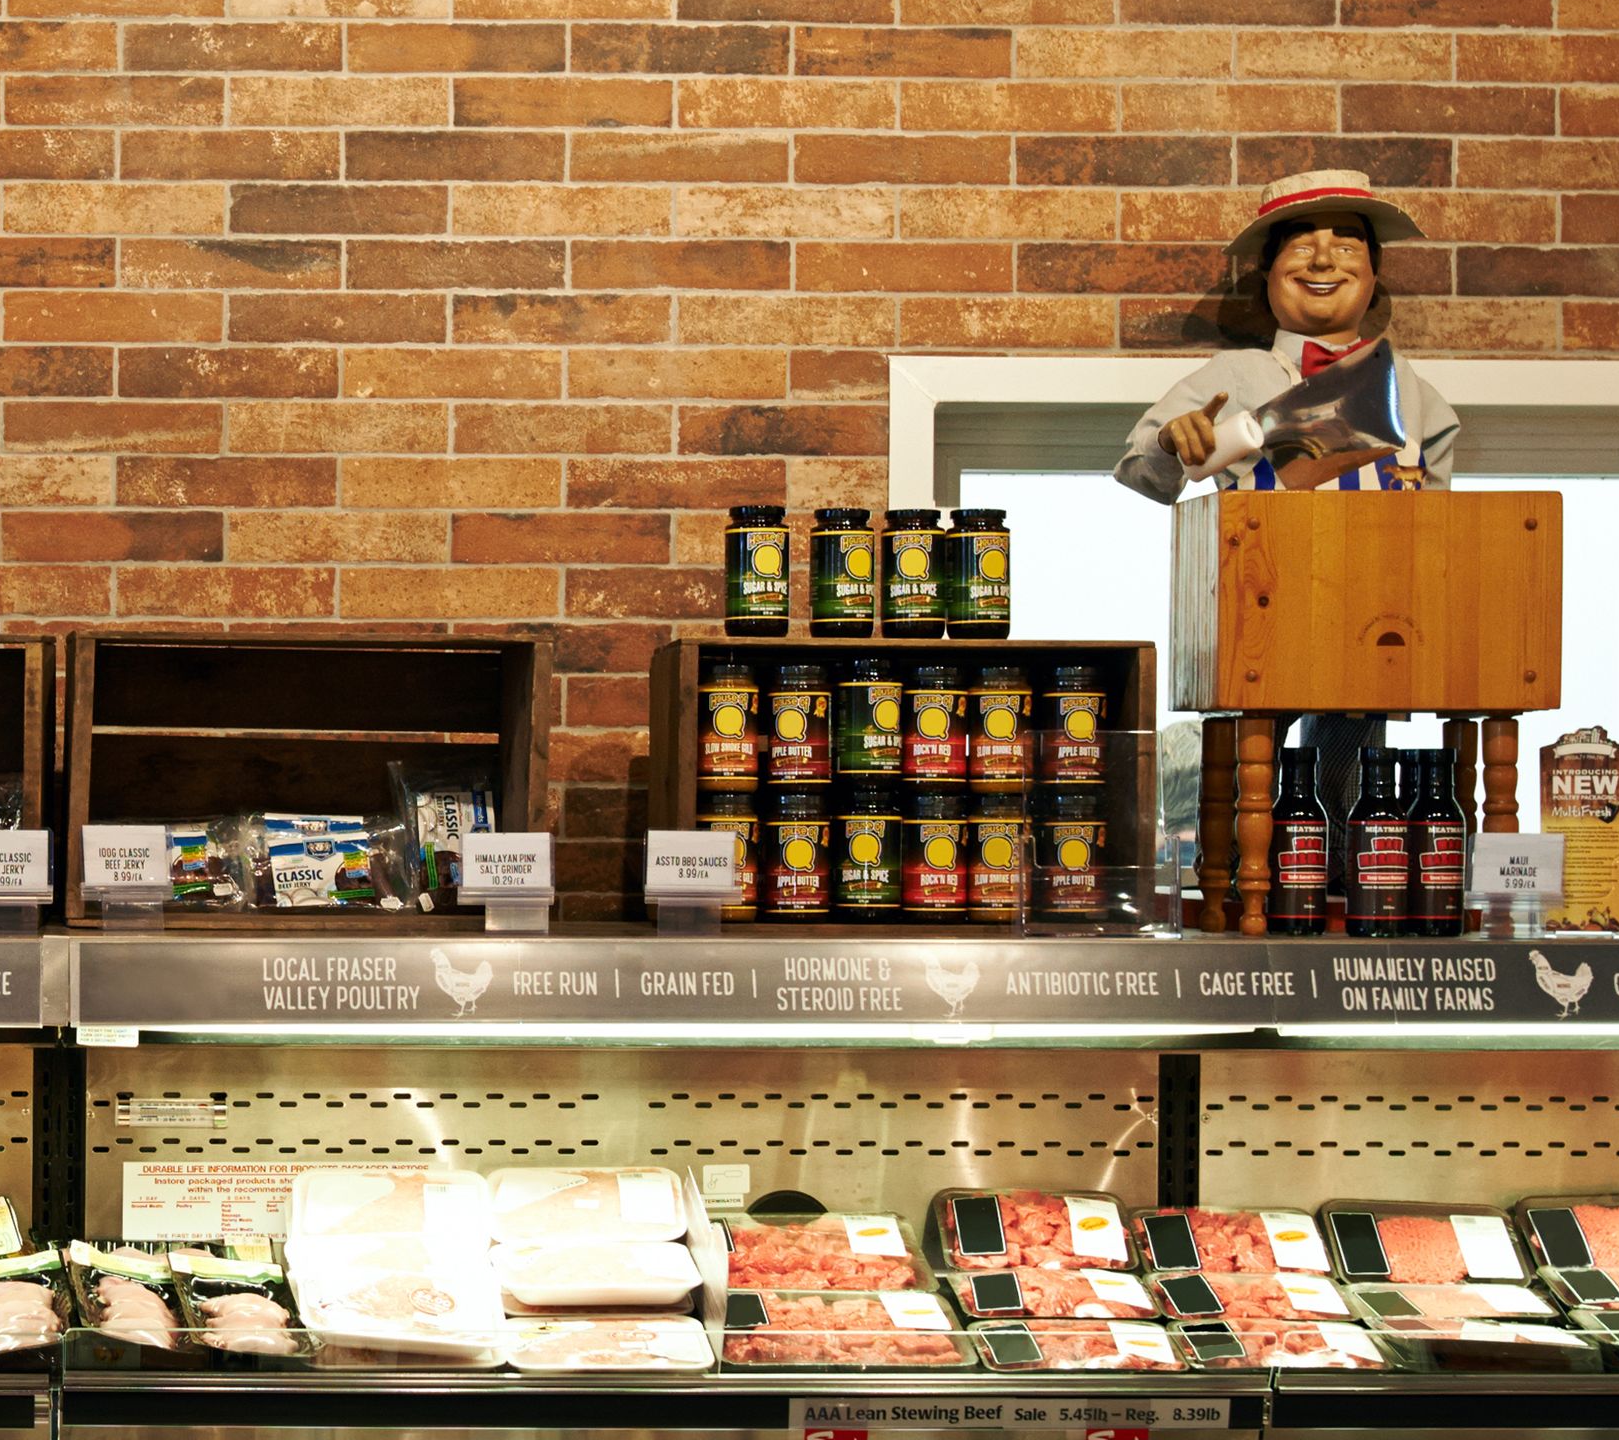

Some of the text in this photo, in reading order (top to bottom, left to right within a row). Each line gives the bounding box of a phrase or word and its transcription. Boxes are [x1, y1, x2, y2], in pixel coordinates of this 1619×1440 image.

[1552, 776, 1619, 795] NEW
[1551, 804, 1612, 818] MultiFresh
[0, 853, 32, 863] CLASSIC
[98, 848, 150, 859] 100G CLASSIC
[475, 854, 537, 863] HIMALAYAN PINK
[655, 856, 728, 867] ASSTD BBQ SAUCES
[1509, 856, 1529, 865] MAUI
[1, 864, 25, 874] JERKY
[105, 860, 145, 870] BEEF JERKY
[480, 864, 532, 874] SALT GRINDER
[1499, 867, 1537, 876] MARINADE
[276, 869, 323, 883] CLASSIC
[263, 958, 396, 982] LOCAL FRASER
[785, 958, 890, 982] HORMONE &
[1333, 957, 1496, 982] HUMANELY RAISED
[513, 971, 597, 996] FREE RUN
[640, 971, 734, 996] GRAIN FED
[1006, 971, 1159, 995] ANTIBIOTIC FREE
[1200, 971, 1295, 996] CAGE FREE
[264, 986, 419, 1011] VALLEY POULTRY
[777, 987, 902, 1011] STEROID FREE
[1342, 987, 1494, 1011] ON FAMILY FARMS
[142, 1165, 288, 1174] DURABLE LIFE INFORMATION FOR
[804, 1405, 1003, 1424] AAA Lean Stewing Beef
[1014, 1408, 1221, 1425] Sale 5.45lb Reg. 8.39lb
